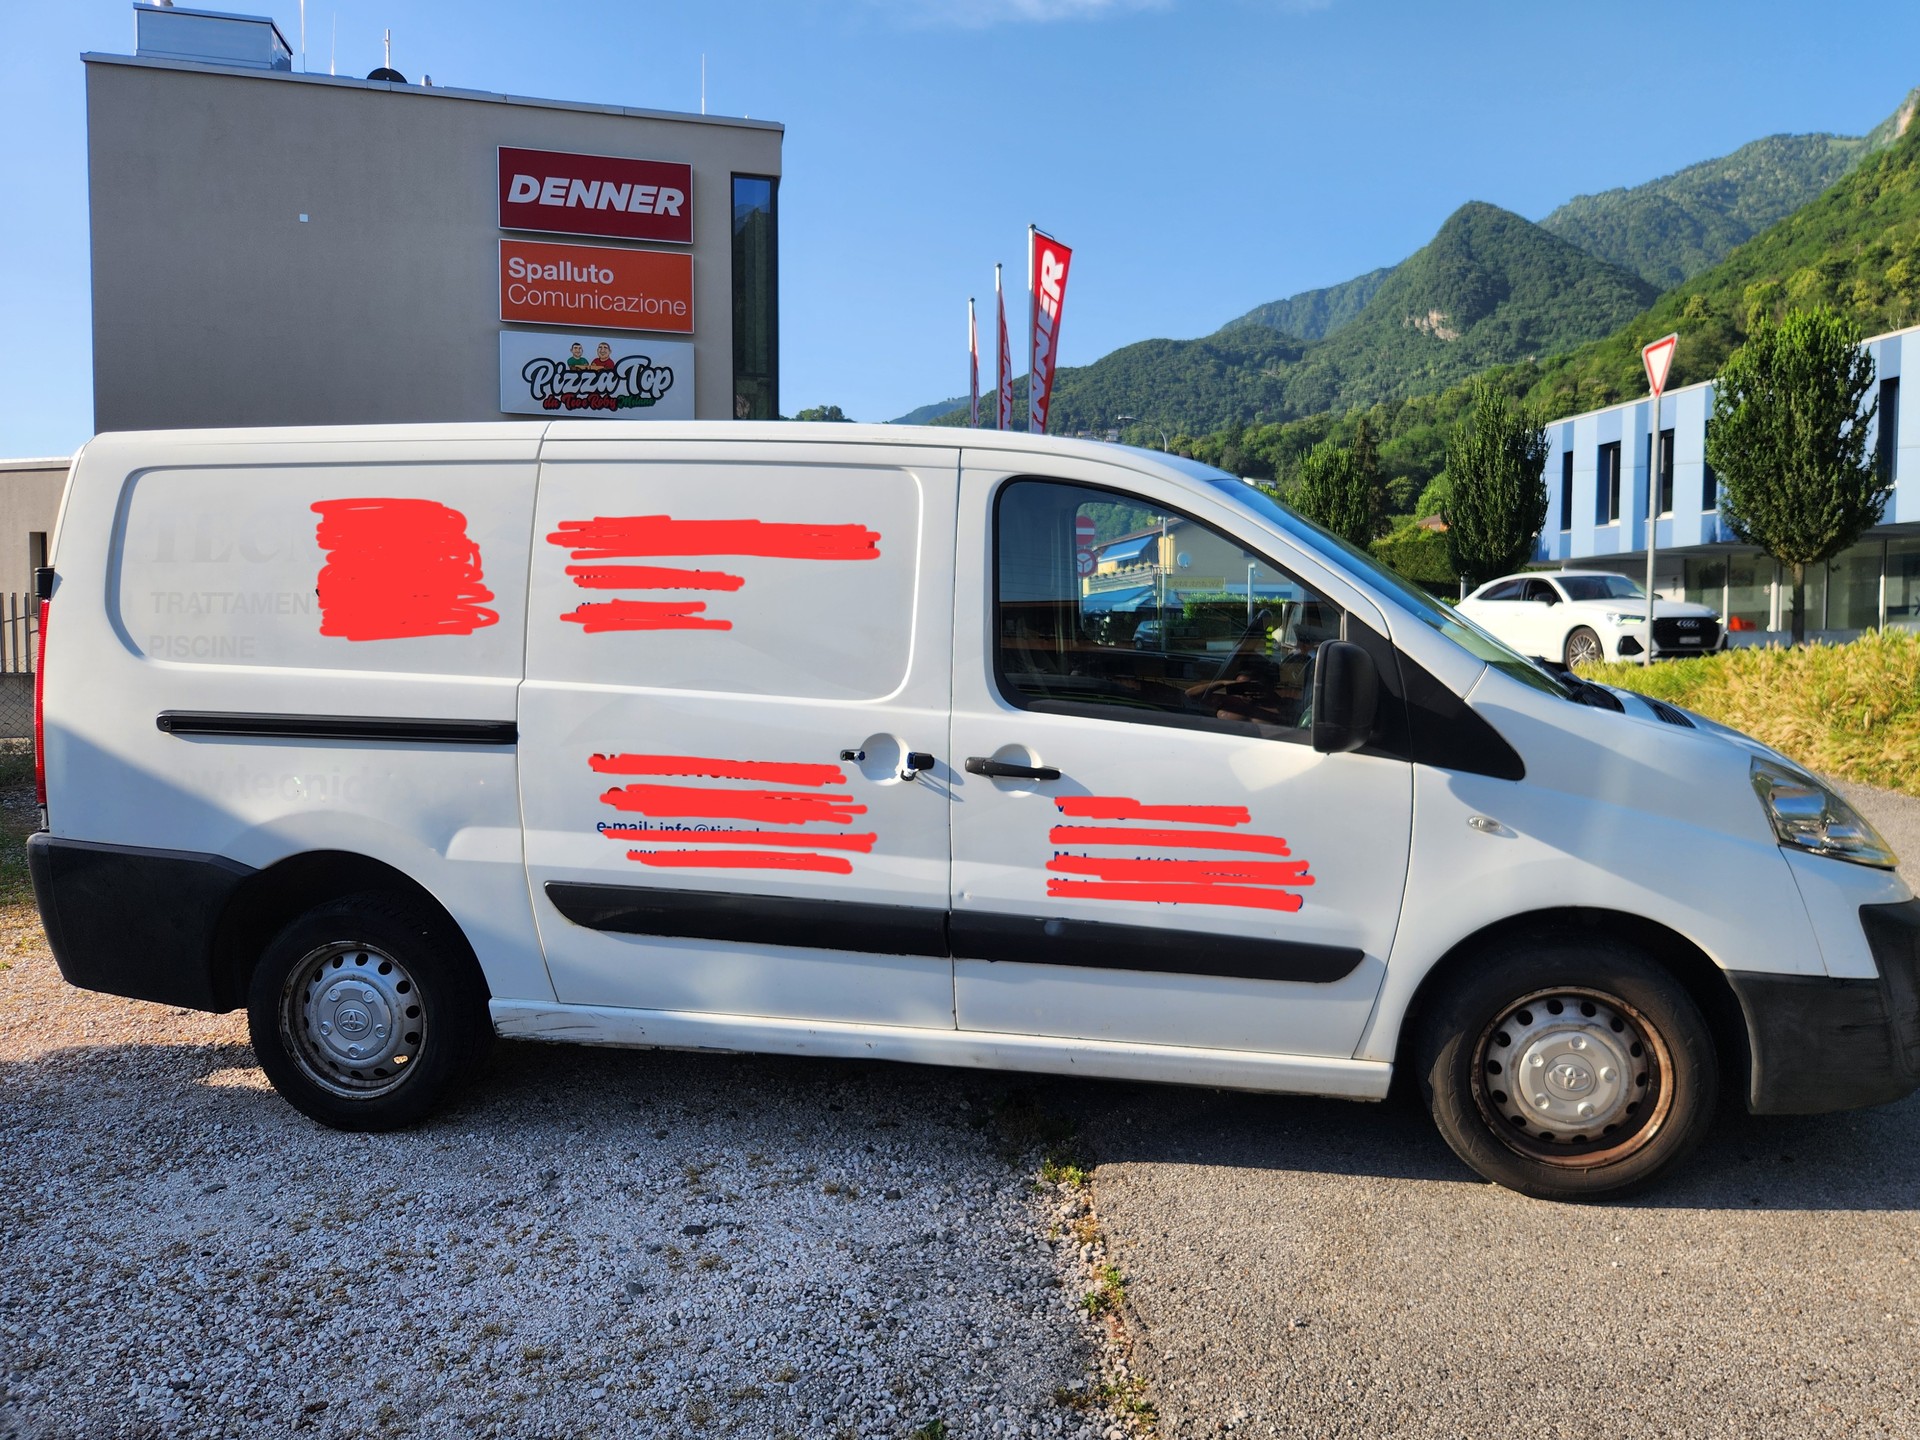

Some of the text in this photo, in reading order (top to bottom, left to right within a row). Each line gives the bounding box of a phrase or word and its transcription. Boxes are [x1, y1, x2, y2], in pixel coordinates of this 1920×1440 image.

[507, 174, 685, 217] DENNER
[508, 257, 614, 285] Spalluto
[508, 283, 687, 316] Comunicazione
[1031, 249, 1064, 434] NNER
[522, 355, 675, 400] Pizza Top
[150, 591, 318, 615] TRATTAMEN
[148, 634, 256, 659] PISCINE
